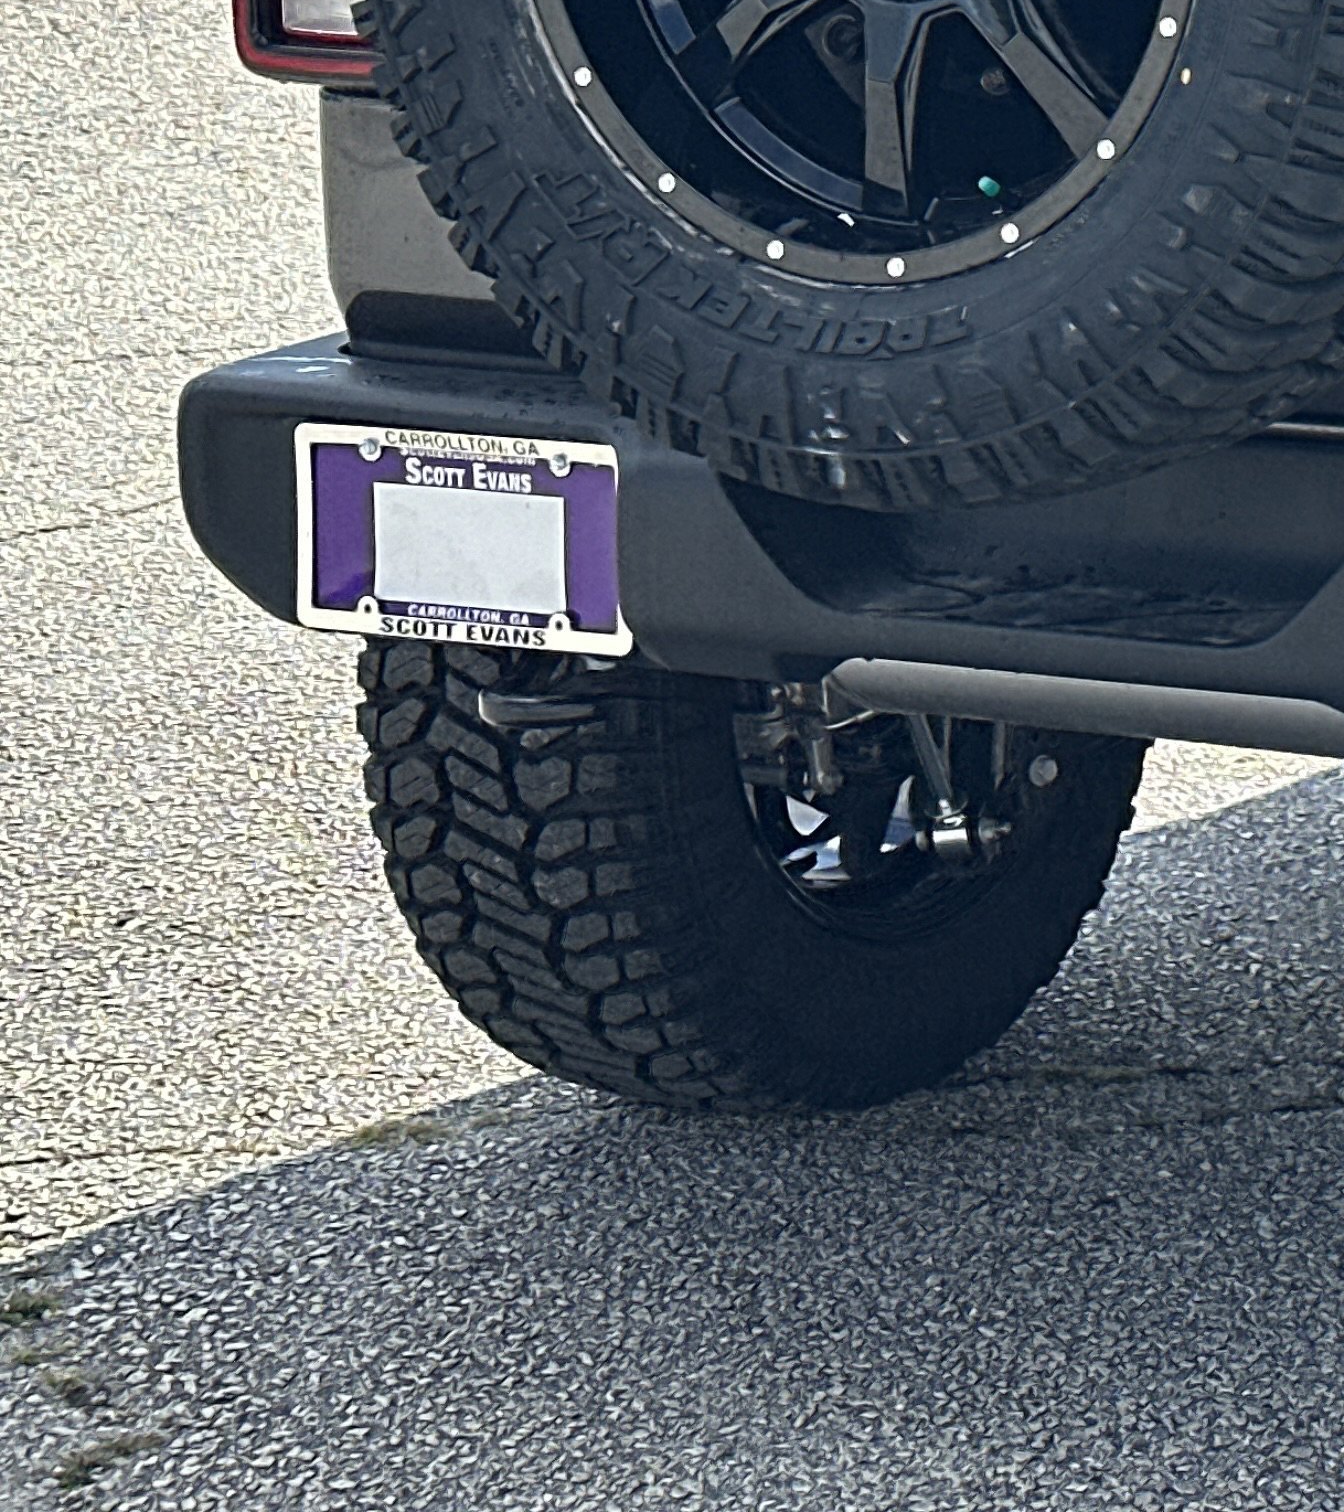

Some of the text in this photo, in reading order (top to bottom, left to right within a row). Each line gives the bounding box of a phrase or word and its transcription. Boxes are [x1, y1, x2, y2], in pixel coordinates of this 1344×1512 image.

[512, 439, 541, 457] GA
[404, 456, 467, 488] SCOTT
[471, 462, 533, 494] EVANS
[378, 616, 547, 647] SCOTT EVANS
[509, 612, 530, 627] GA
